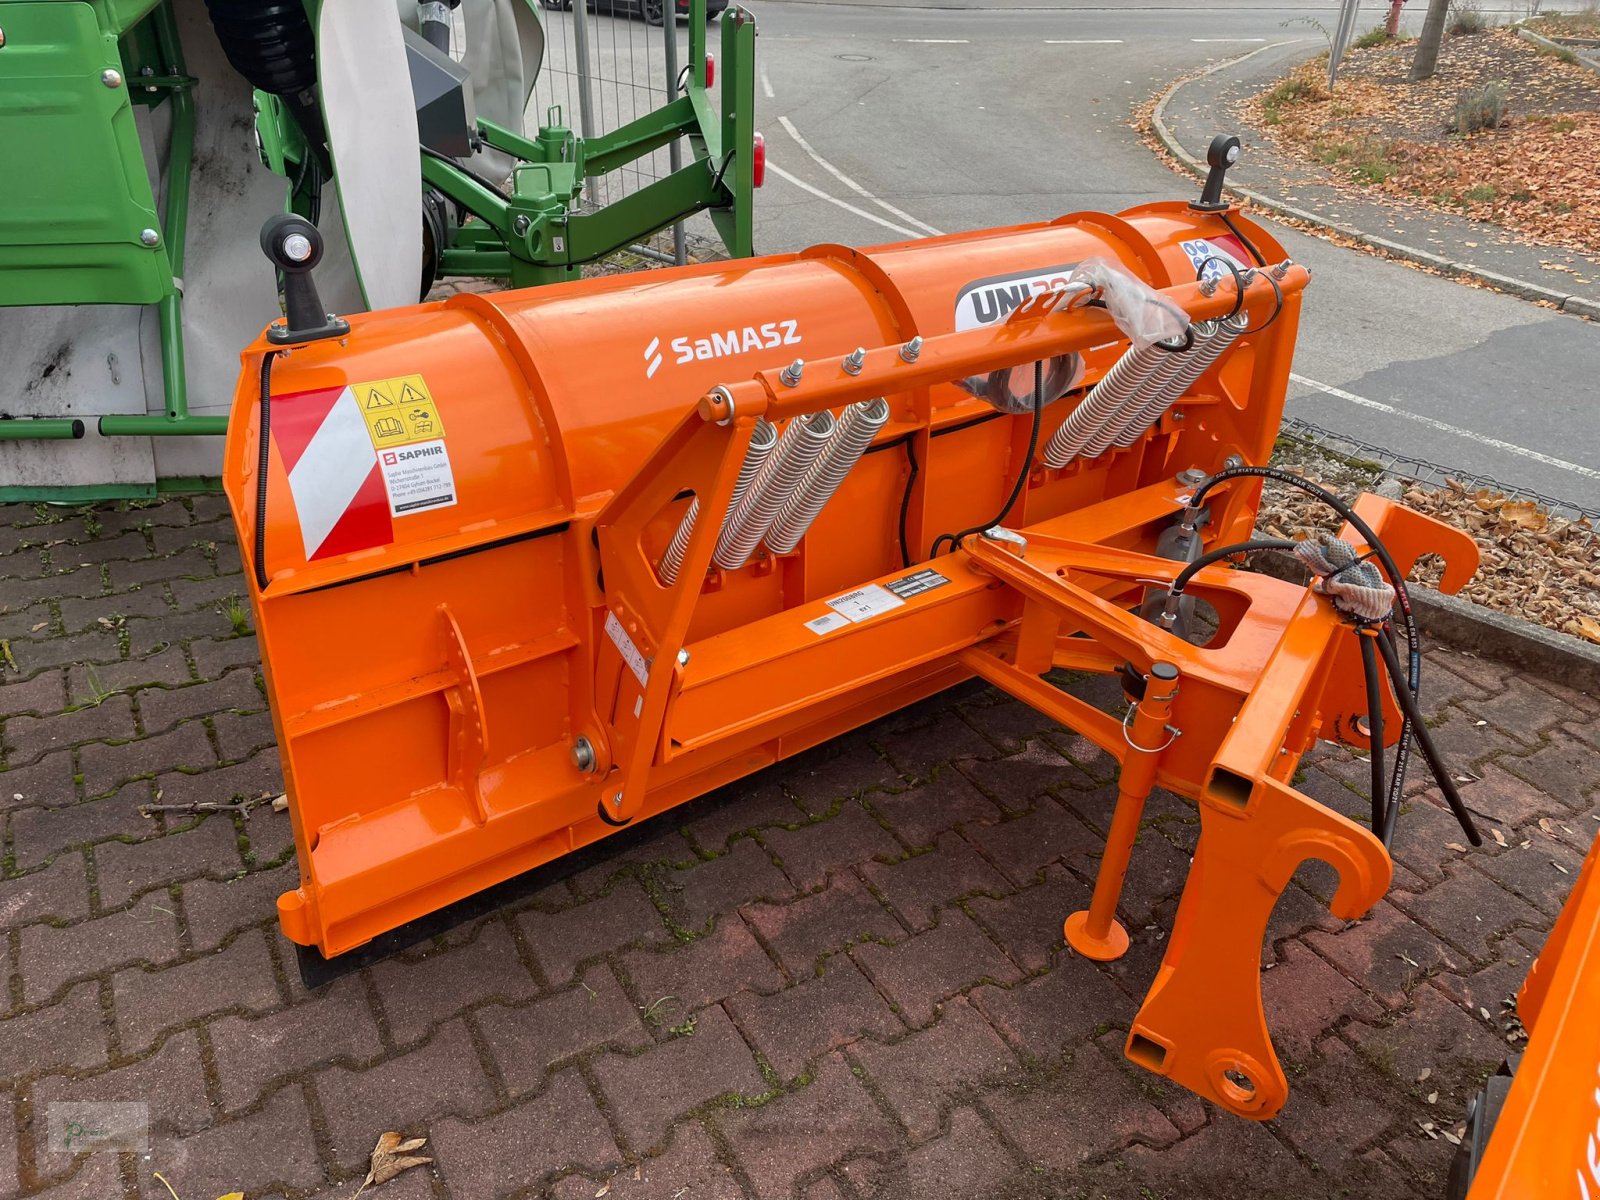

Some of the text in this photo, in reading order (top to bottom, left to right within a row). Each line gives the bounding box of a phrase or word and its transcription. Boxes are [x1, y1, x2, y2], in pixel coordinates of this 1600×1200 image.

[671, 319, 802, 365] SaMASZ
[398, 446, 443, 461] SAPHIR
[1281, 473, 1292, 481] 215
[1292, 478, 1306, 488] BAR
[1409, 627, 1416, 636] EN
